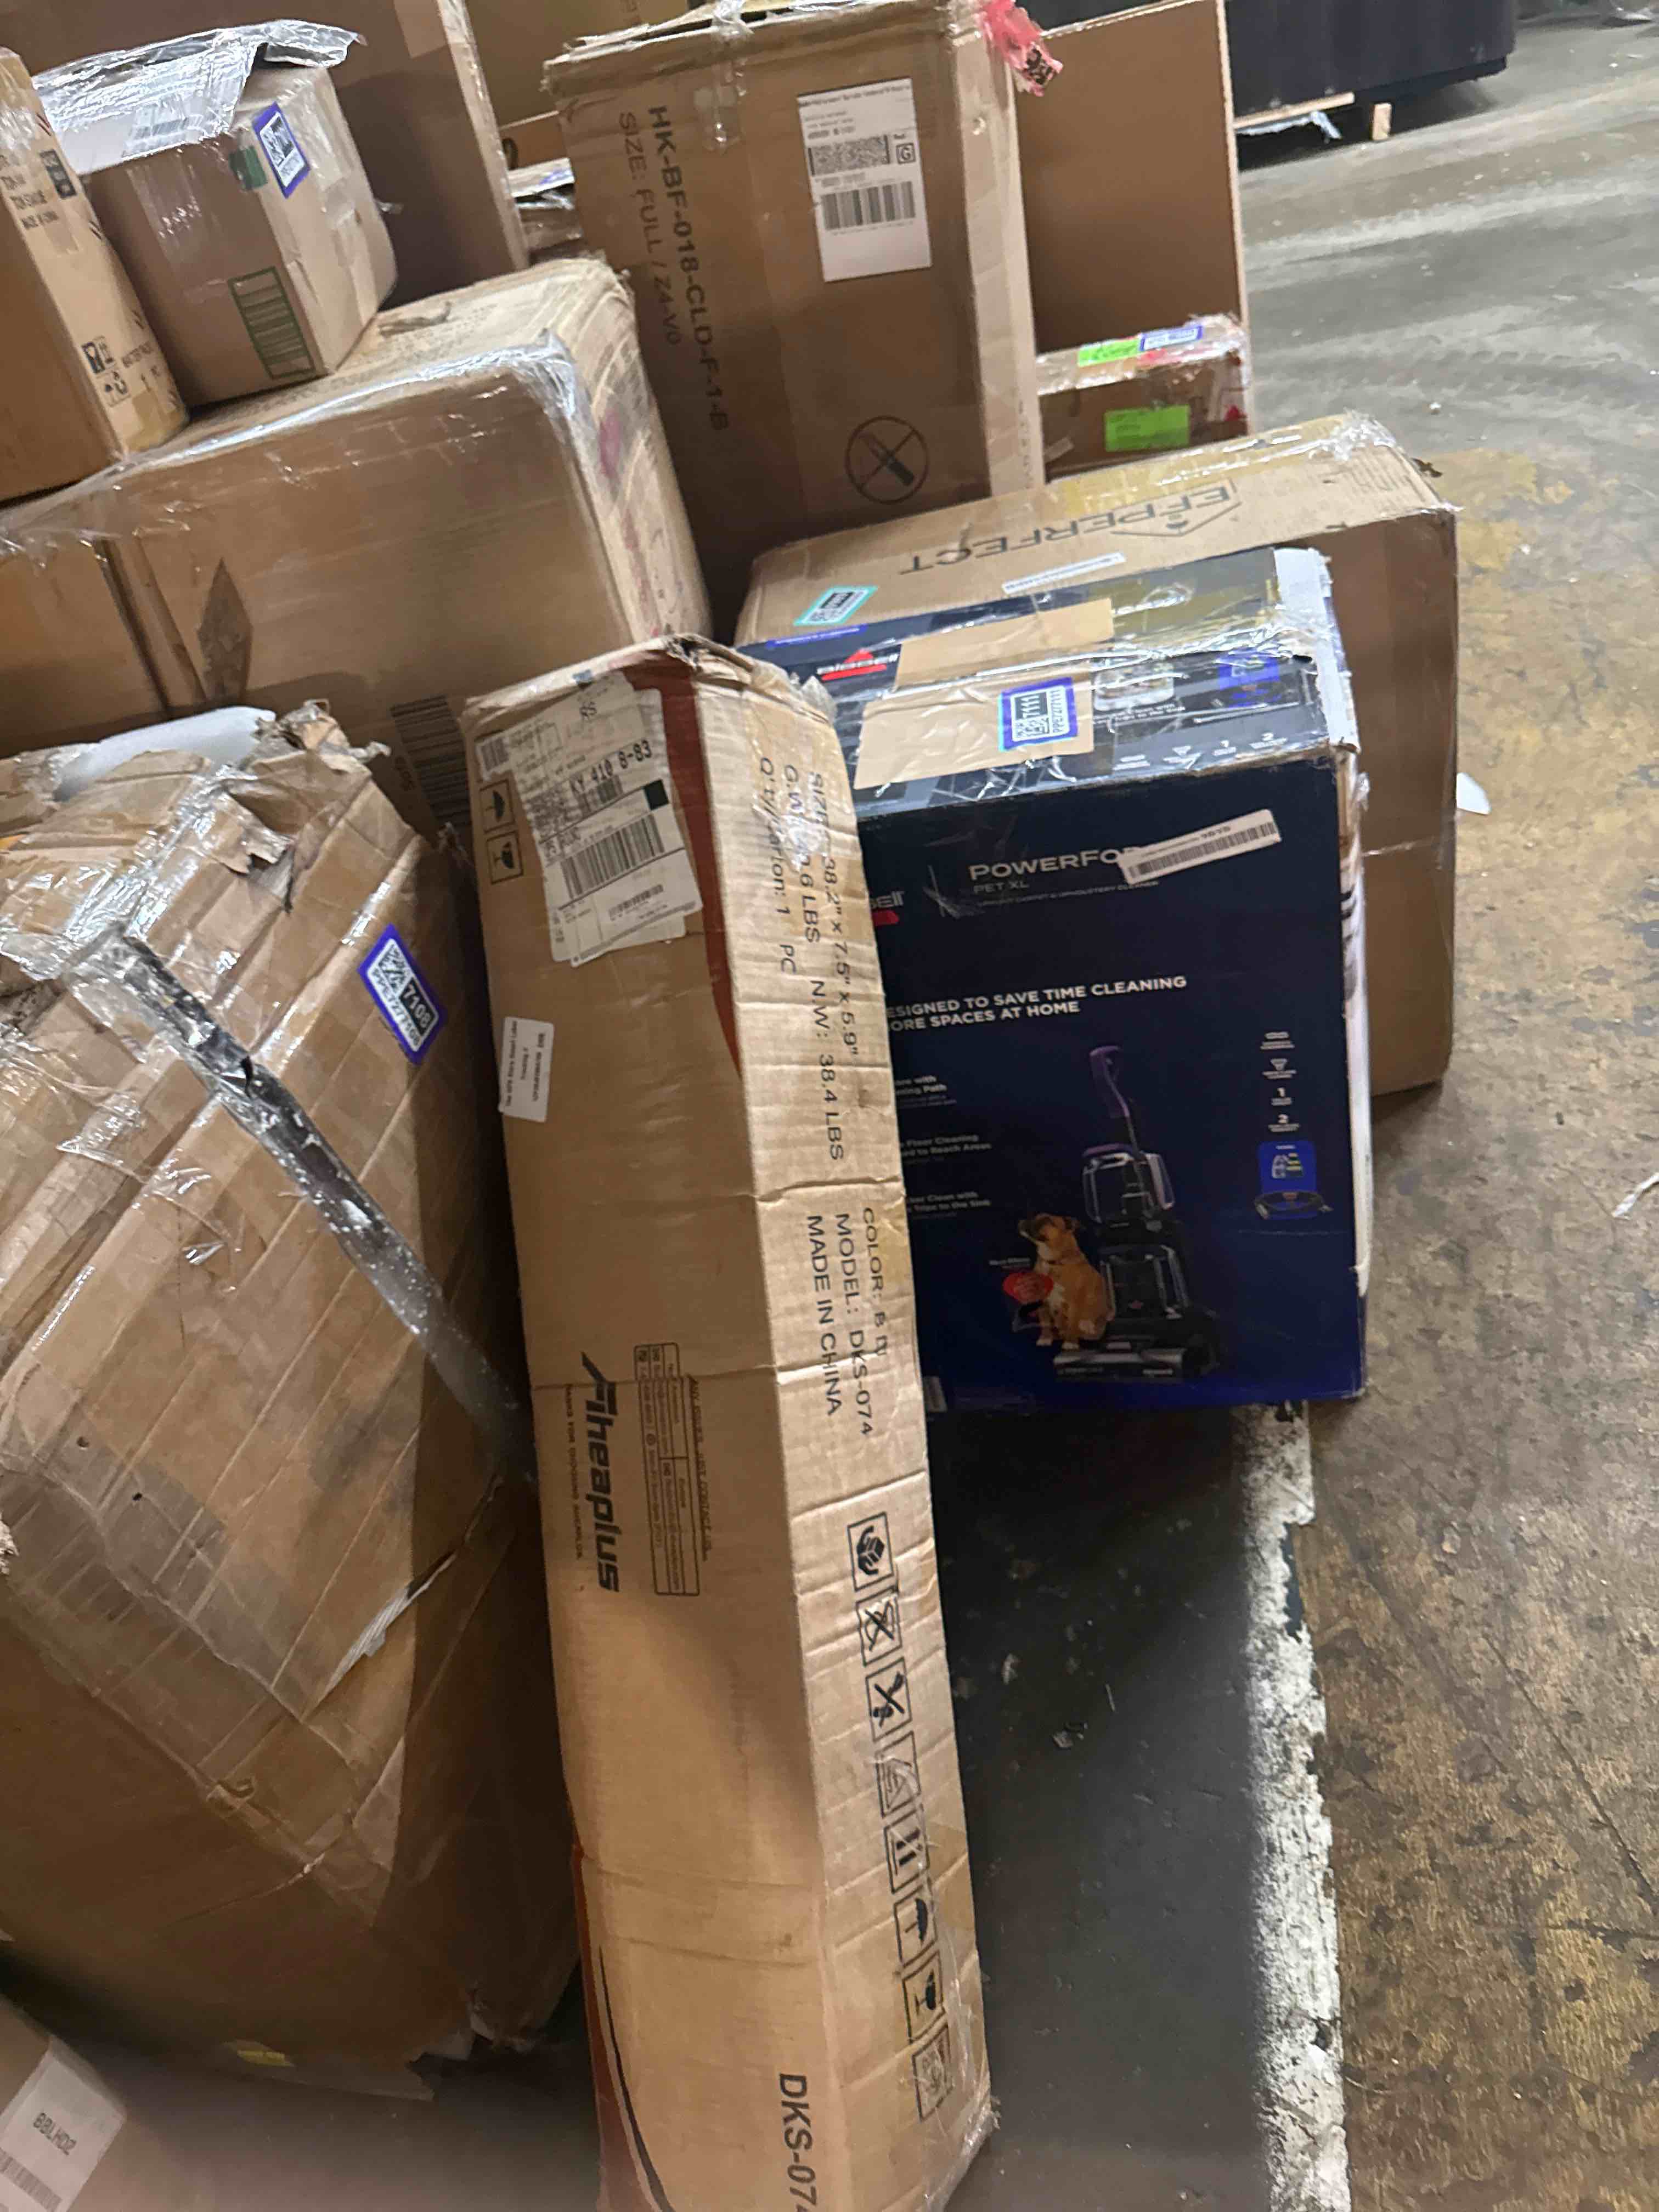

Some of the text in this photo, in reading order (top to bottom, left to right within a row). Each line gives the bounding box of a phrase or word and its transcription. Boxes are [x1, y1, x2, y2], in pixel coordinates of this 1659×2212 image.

[619, 112, 647, 180] SIZE:
[635, 188, 661, 253] FULL
[1020, 695, 1040, 718] 7111
[968, 847, 1140, 880] POWERFO
[974, 879, 1030, 894] PET XL
[775, 905, 790, 916] 1
[802, 895, 820, 943] LBS
[780, 944, 796, 974] PC
[833, 941, 852, 985] 7.5"
[404, 986, 431, 1029] 7108
[887, 975, 1187, 1019] ESIGNED TO SAVE TIME CLEANING
[888, 1001, 1080, 1032] ORE SPACES AT HOME
[819, 1054, 838, 1104] 38.4
[826, 1111, 844, 1160] LBS
[864, 1207, 884, 1299] COLOR:
[807, 1216, 843, 1417] MADE IN CHINA
[835, 1213, 873, 1436] MODEL: DKS-074
